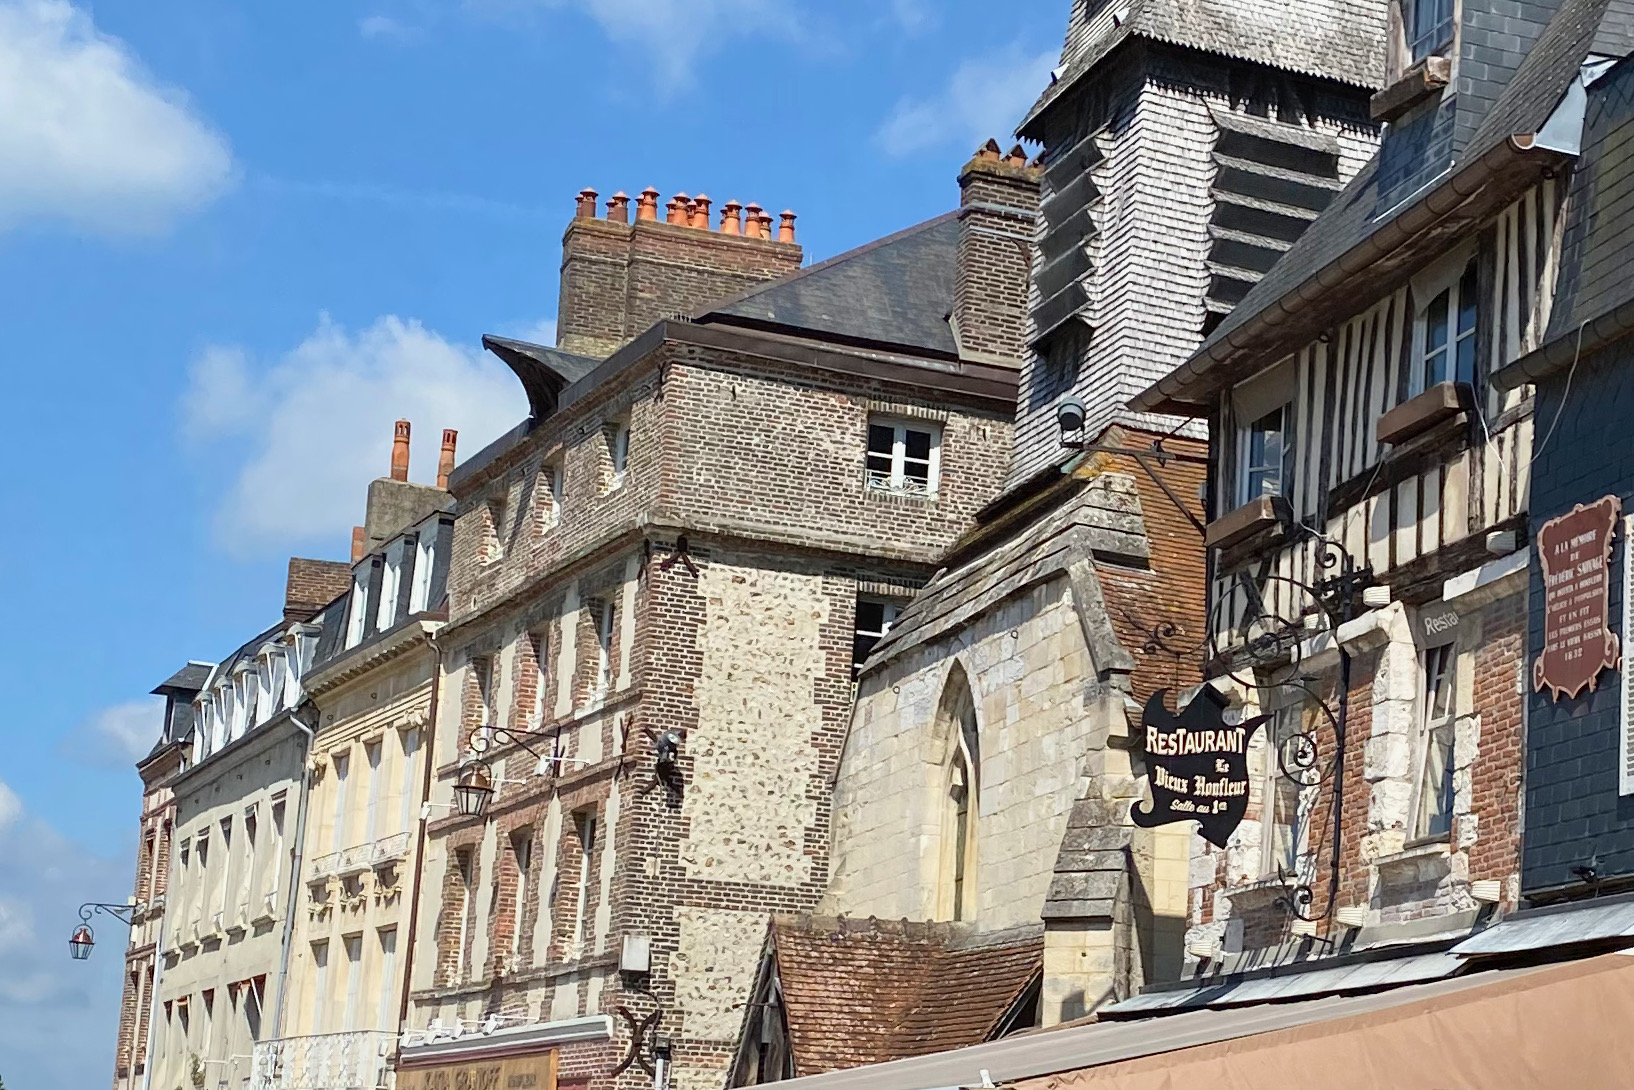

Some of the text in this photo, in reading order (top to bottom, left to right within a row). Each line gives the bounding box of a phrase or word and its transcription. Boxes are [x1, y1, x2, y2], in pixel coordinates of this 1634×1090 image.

[1145, 724, 1246, 756] RESTAURANT
[1154, 765, 1247, 797] Vieux Honfleur
